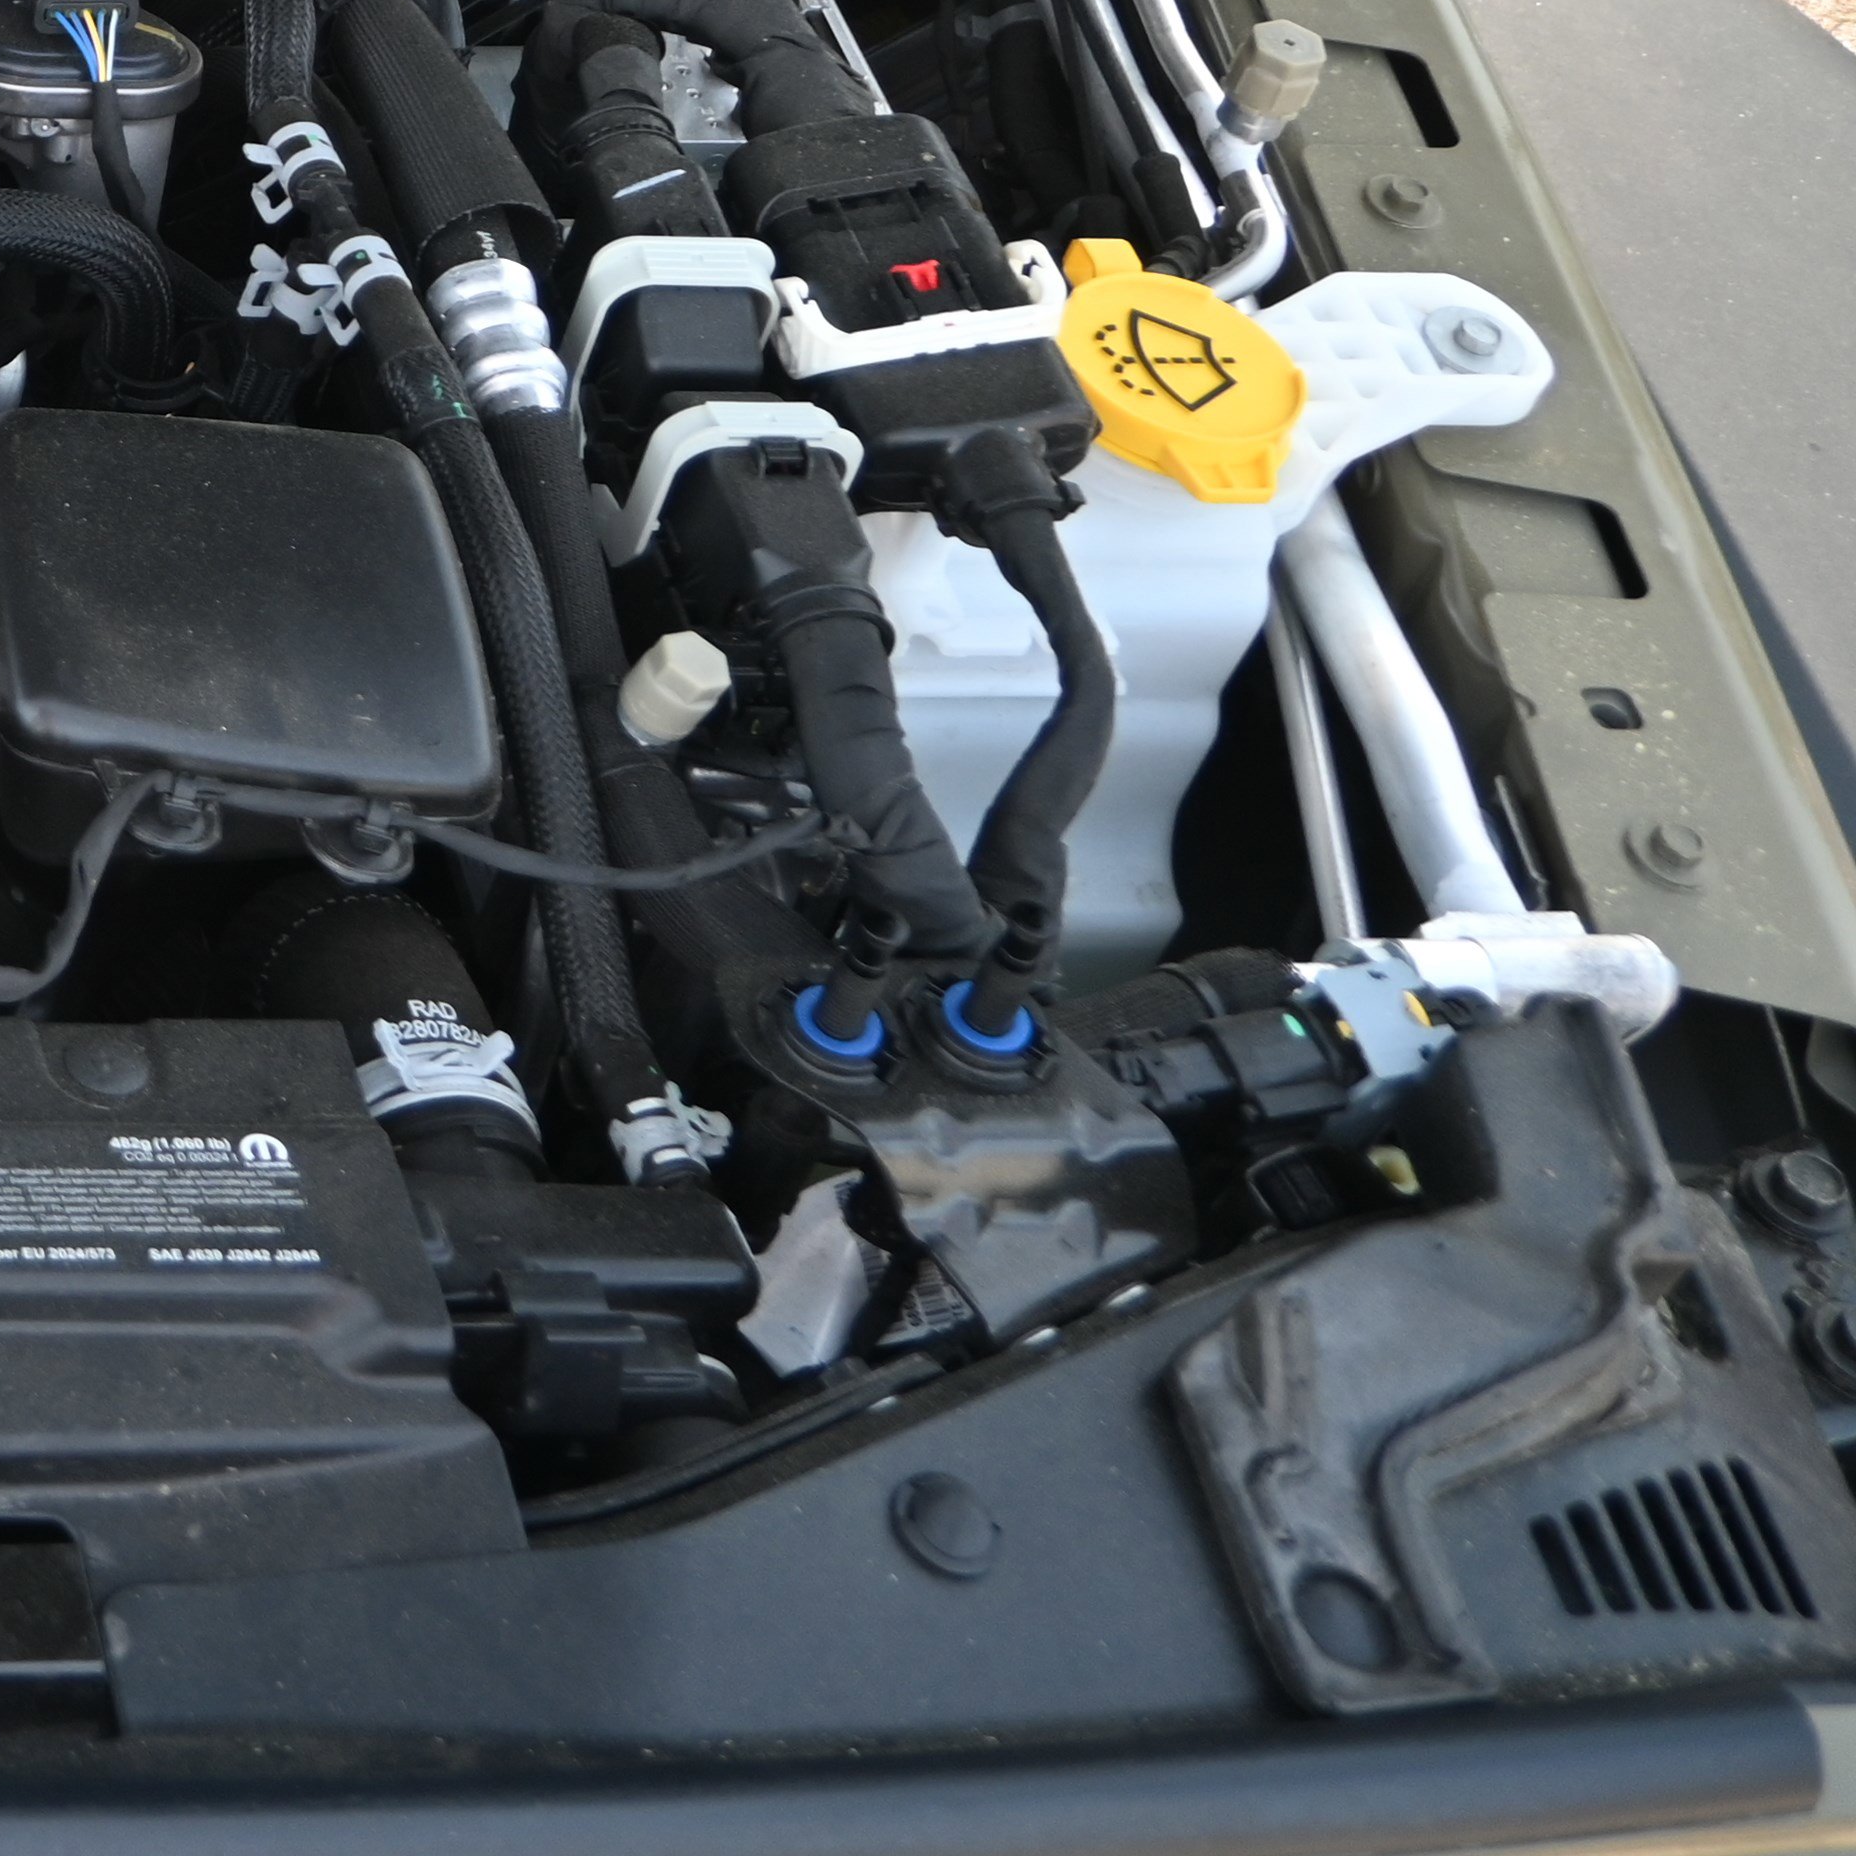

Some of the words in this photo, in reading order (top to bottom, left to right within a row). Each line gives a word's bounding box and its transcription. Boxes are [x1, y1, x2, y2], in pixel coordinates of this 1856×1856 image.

[408, 999, 458, 1020] RAD
[122, 1151, 154, 1162] CO2
[20, 1246, 45, 1260] EU
[148, 1247, 184, 1262] SAE
